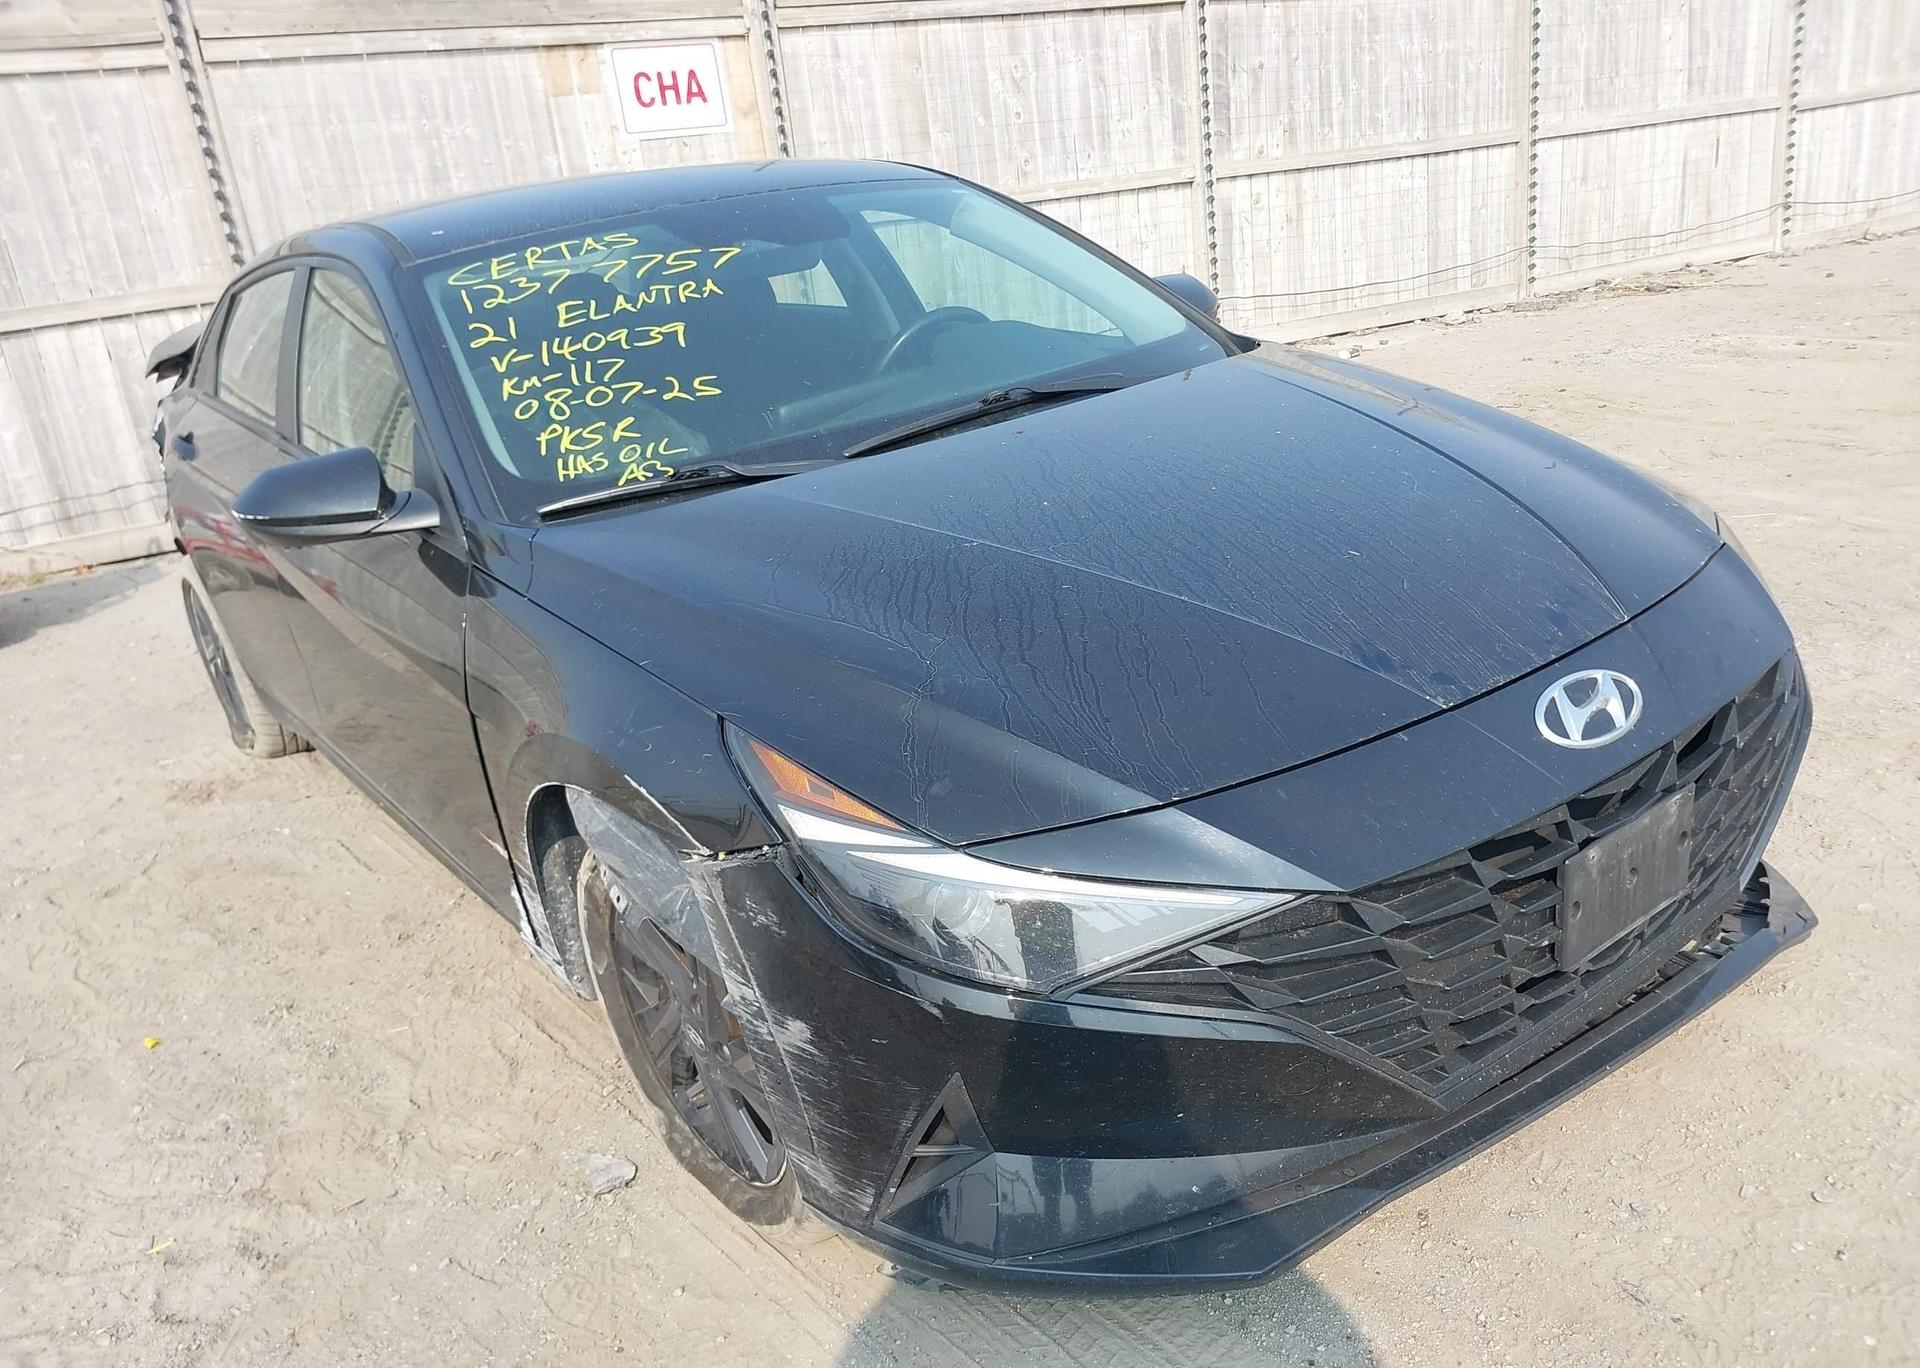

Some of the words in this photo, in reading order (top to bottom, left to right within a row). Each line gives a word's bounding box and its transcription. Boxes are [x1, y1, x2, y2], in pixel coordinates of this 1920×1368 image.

[633, 69, 708, 108] CHA
[447, 233, 639, 286] CERTAS
[460, 268, 572, 315] 1237
[592, 246, 743, 284] 7757
[468, 316, 516, 349] 21
[556, 278, 724, 329] ELANTRA
[513, 374, 723, 421] 08-07-25
[556, 451, 609, 482] HAS
[618, 437, 689, 463] OIL
